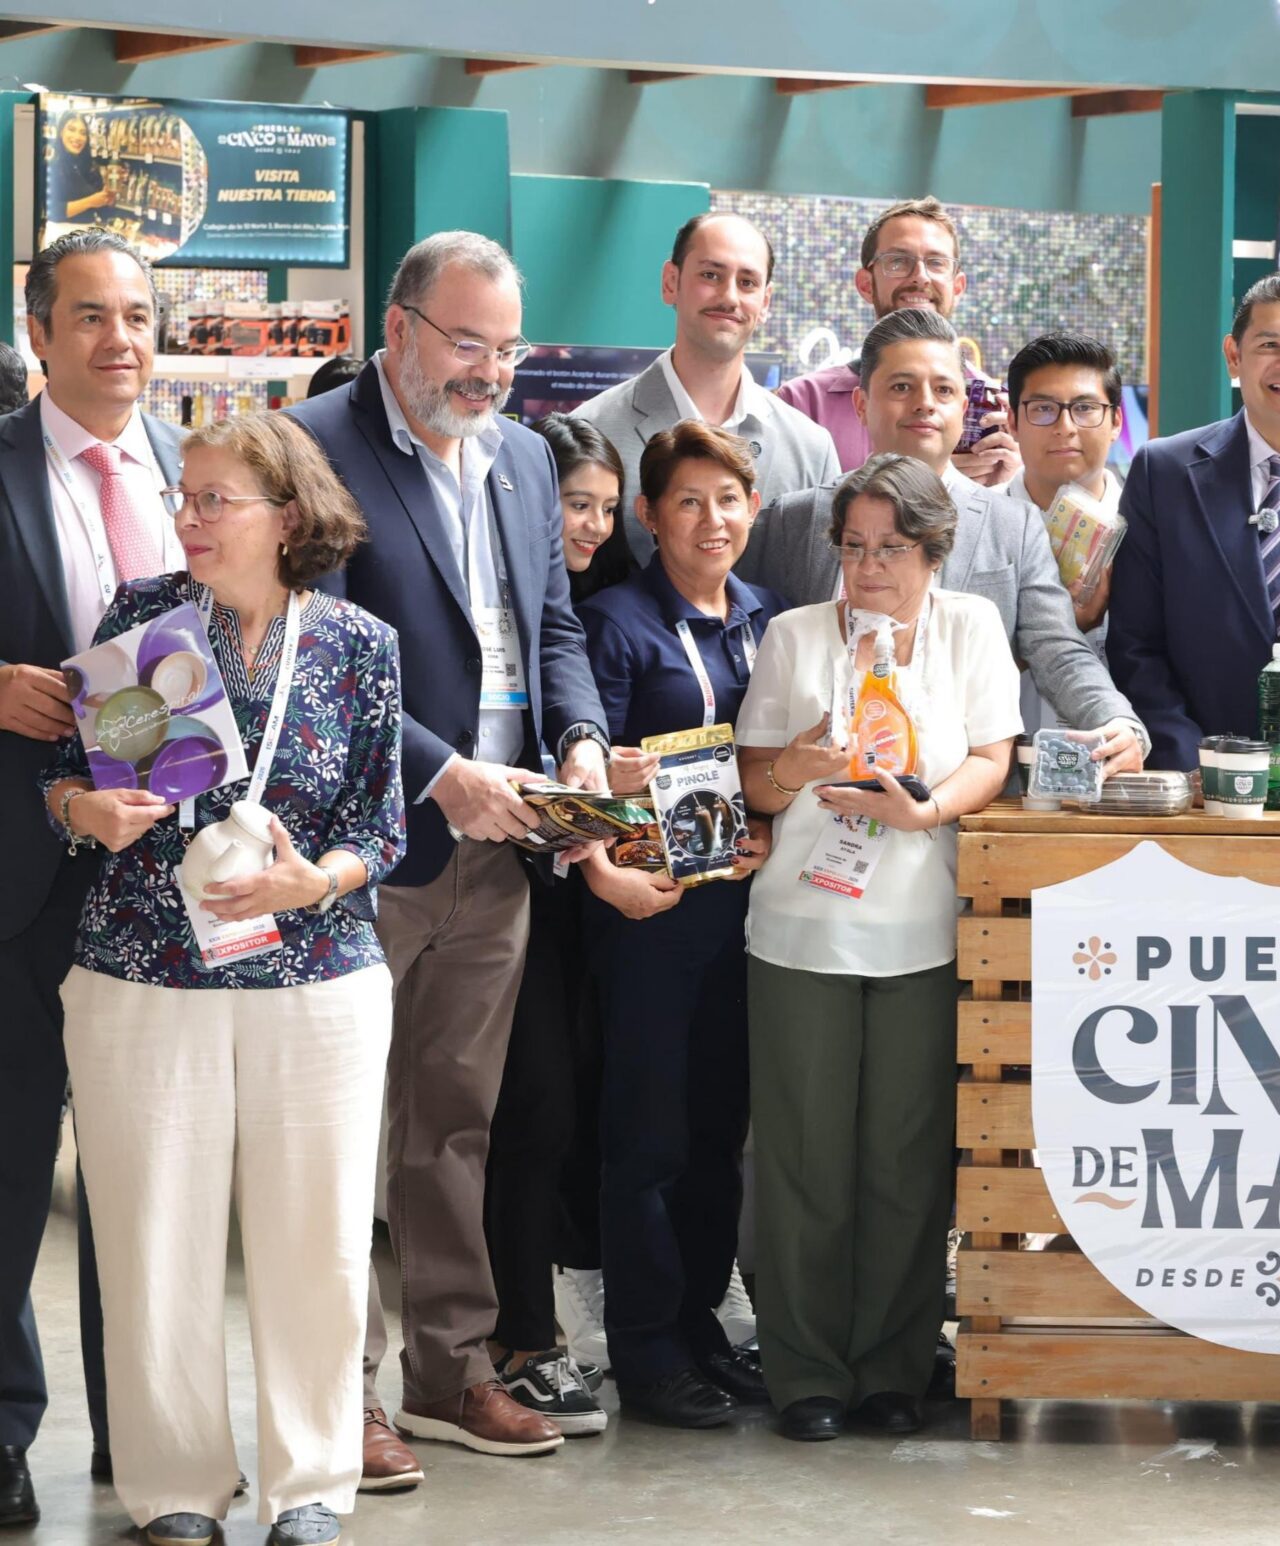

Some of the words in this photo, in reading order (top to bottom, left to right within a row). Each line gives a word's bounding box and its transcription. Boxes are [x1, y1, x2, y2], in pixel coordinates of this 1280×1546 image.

[226, 131, 276, 147] CINCO
[286, 133, 327, 147] MAYO
[255, 169, 299, 183] VISITA
[217, 188, 282, 202] NUESTRA
[286, 188, 336, 202] TIENDA
[677, 770, 720, 787] PINOLE
[839, 839, 862, 850] SANDRA
[1072, 1145, 1138, 1188] DE
[1135, 1267, 1246, 1288] DESDE
